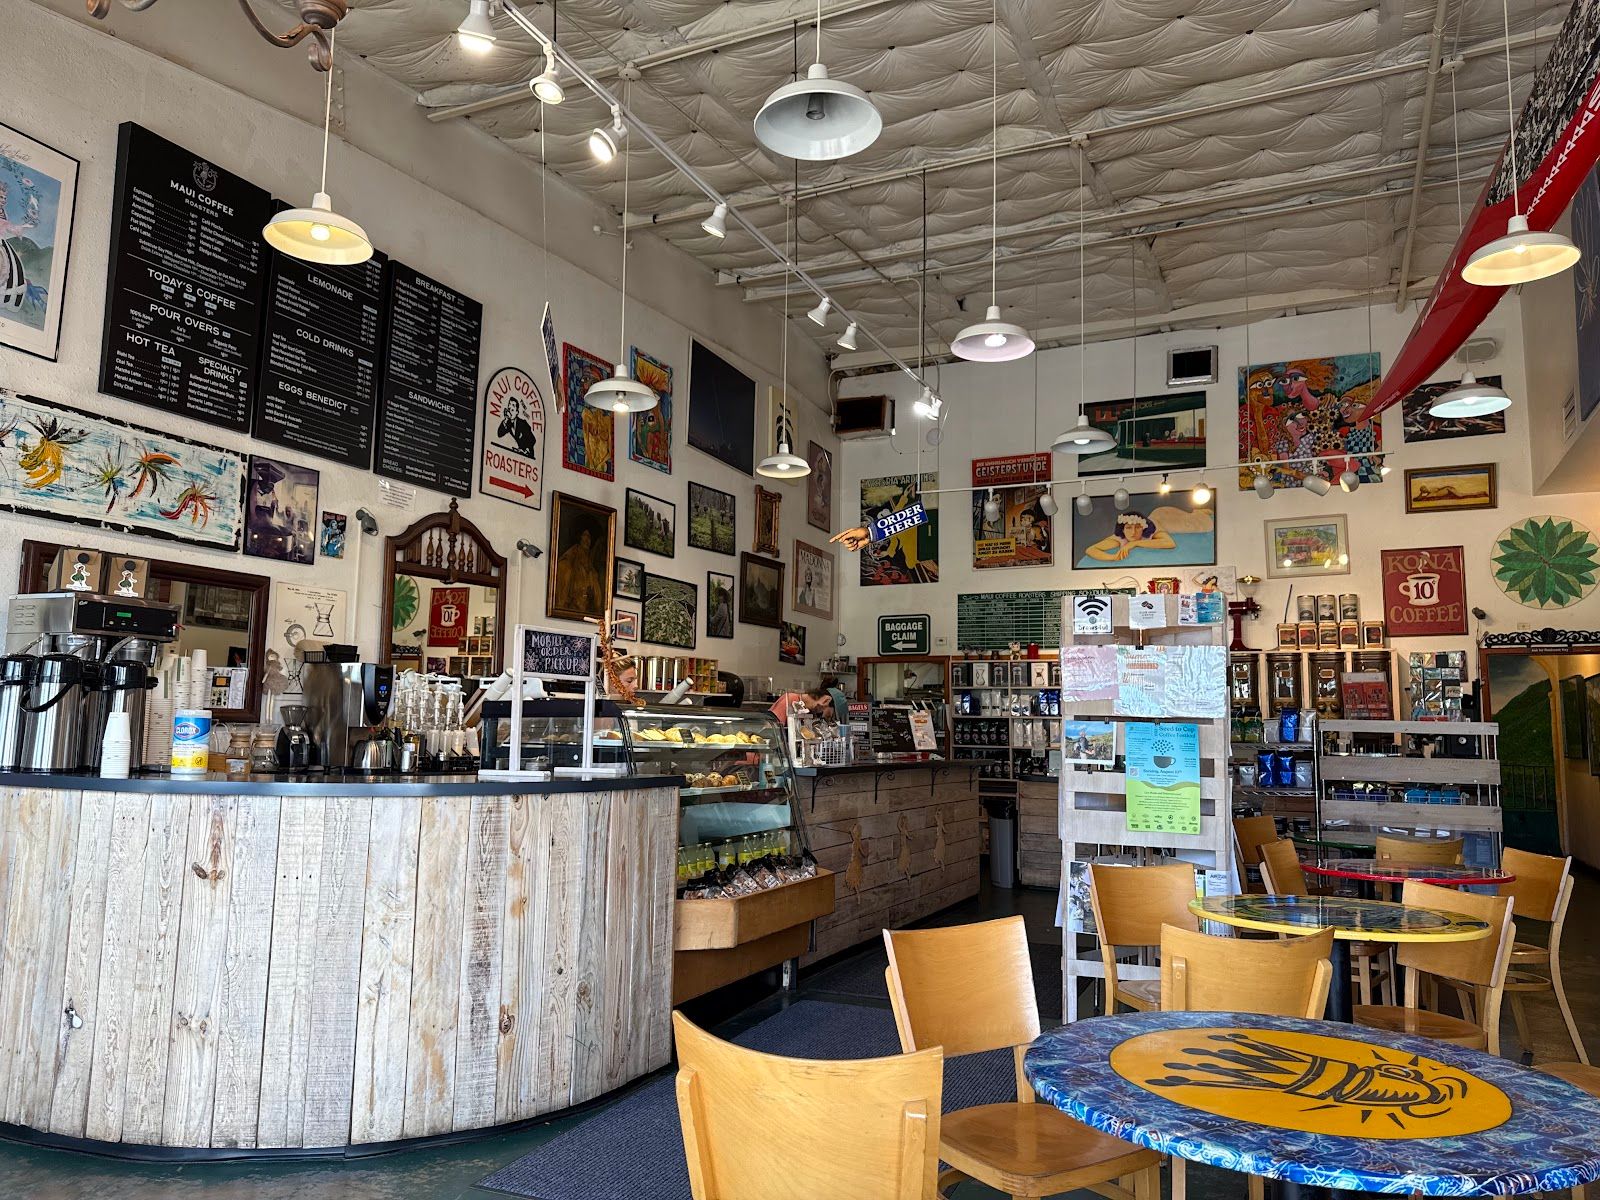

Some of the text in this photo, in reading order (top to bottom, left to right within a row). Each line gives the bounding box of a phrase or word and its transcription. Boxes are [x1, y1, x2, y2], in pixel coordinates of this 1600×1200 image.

[170, 180, 235, 217] MAUI COFFEE
[184, 198, 219, 218] ROASTERS
[147, 268, 236, 310] TODAY'S COFFEE
[307, 274, 353, 301] LEMONADE
[415, 278, 456, 302] BREAKFAST
[149, 303, 219, 336] POUR OVERS
[126, 332, 175, 356] HOT TEA
[295, 328, 354, 357] COLD DRINKS
[198, 356, 241, 377] SPECIALTY
[203, 368, 234, 383] DRINKS
[437, 366, 474, 384] SPECIALTY BAGELS
[278, 382, 302, 396] EGGS
[305, 391, 347, 411] BENEDICT
[408, 391, 455, 414] SANDWICHES
[490, 375, 543, 433] MAUI COFFEE
[485, 449, 538, 483] ROASTERS
[876, 504, 923, 528] ORDER
[884, 514, 922, 537] HERE
[800, 550, 830, 573] MADONNA
[1386, 552, 1460, 576] KONA
[1390, 602, 1461, 624] COFFEE
[885, 622, 923, 631] BAGGAGE
[891, 631, 917, 641] CLAIM
[531, 634, 564, 648] MOBILE
[540, 646, 572, 657] ORDER
[545, 657, 579, 672] PICKUP
